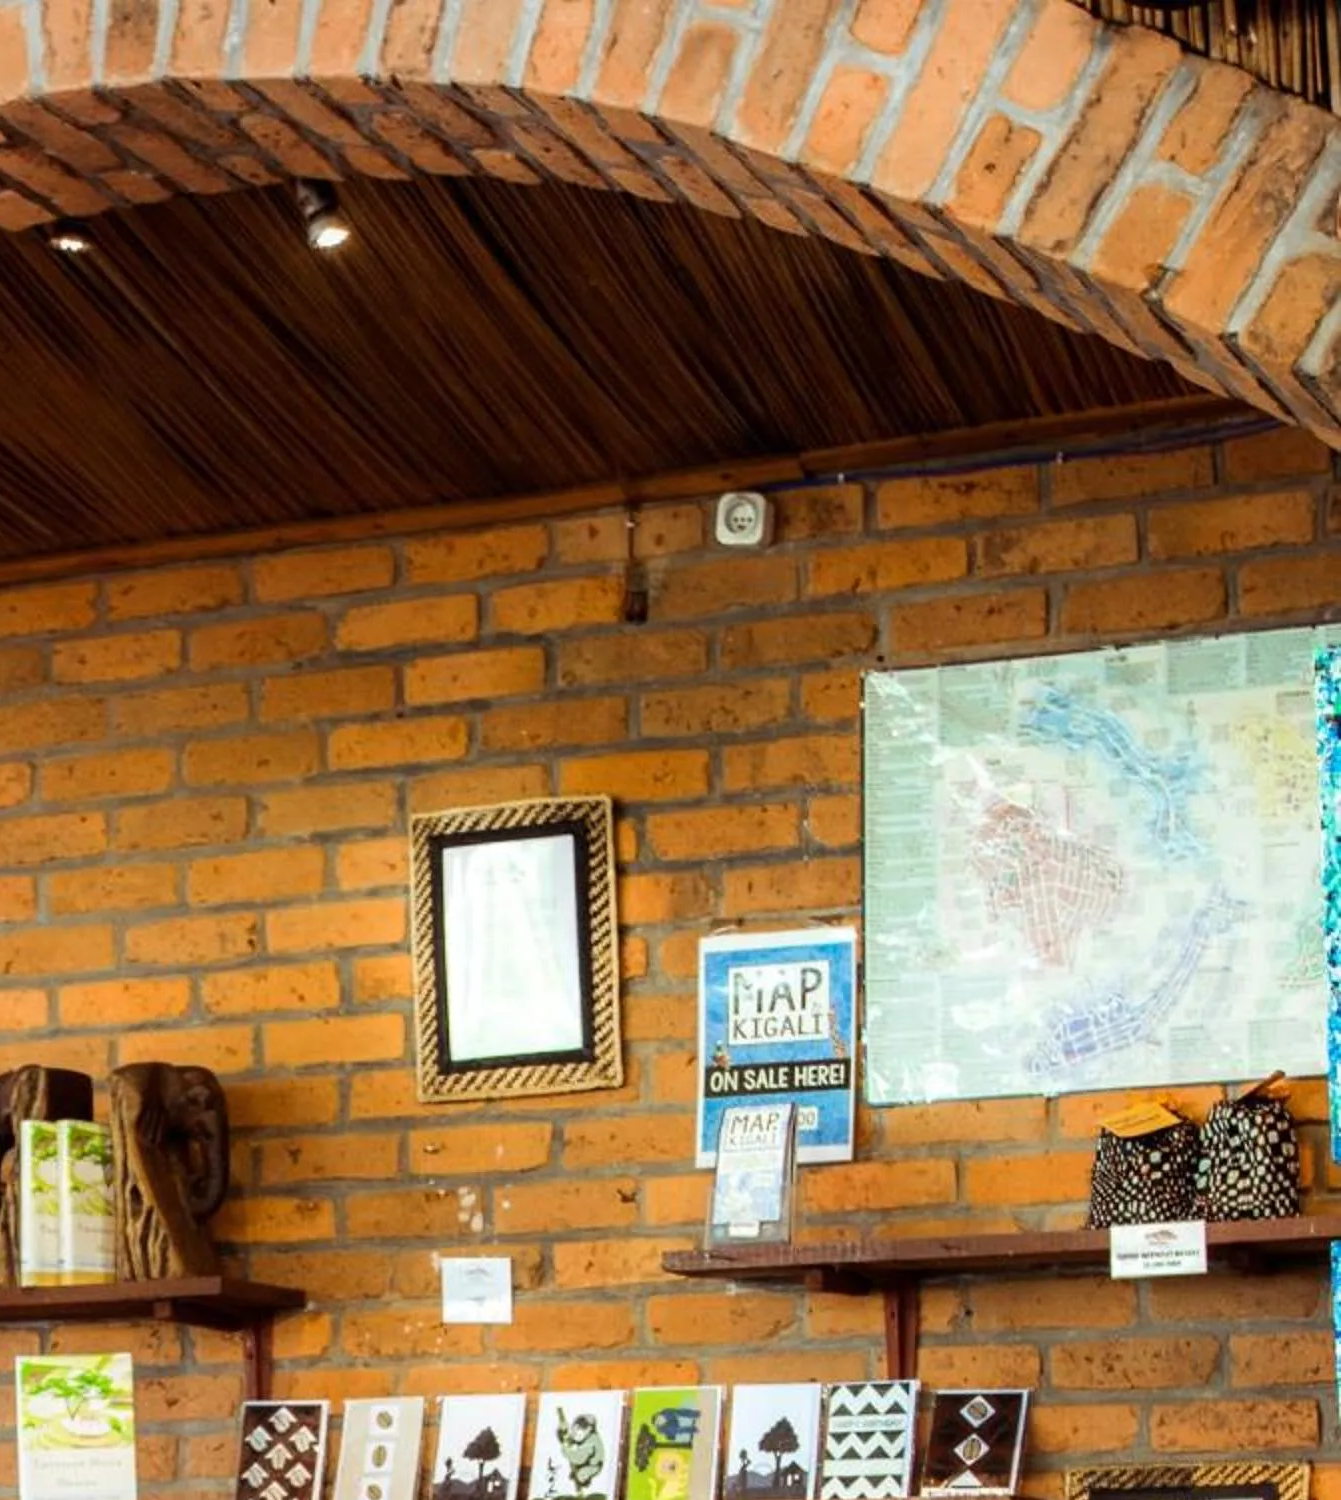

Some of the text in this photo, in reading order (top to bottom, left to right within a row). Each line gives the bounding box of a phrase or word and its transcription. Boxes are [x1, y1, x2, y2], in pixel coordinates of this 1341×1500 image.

[734, 967, 823, 1014] MAP
[733, 1013, 823, 1039] KIGALI
[710, 1063, 846, 1092] ON SALE HERE!
[730, 1111, 780, 1135] MAP
